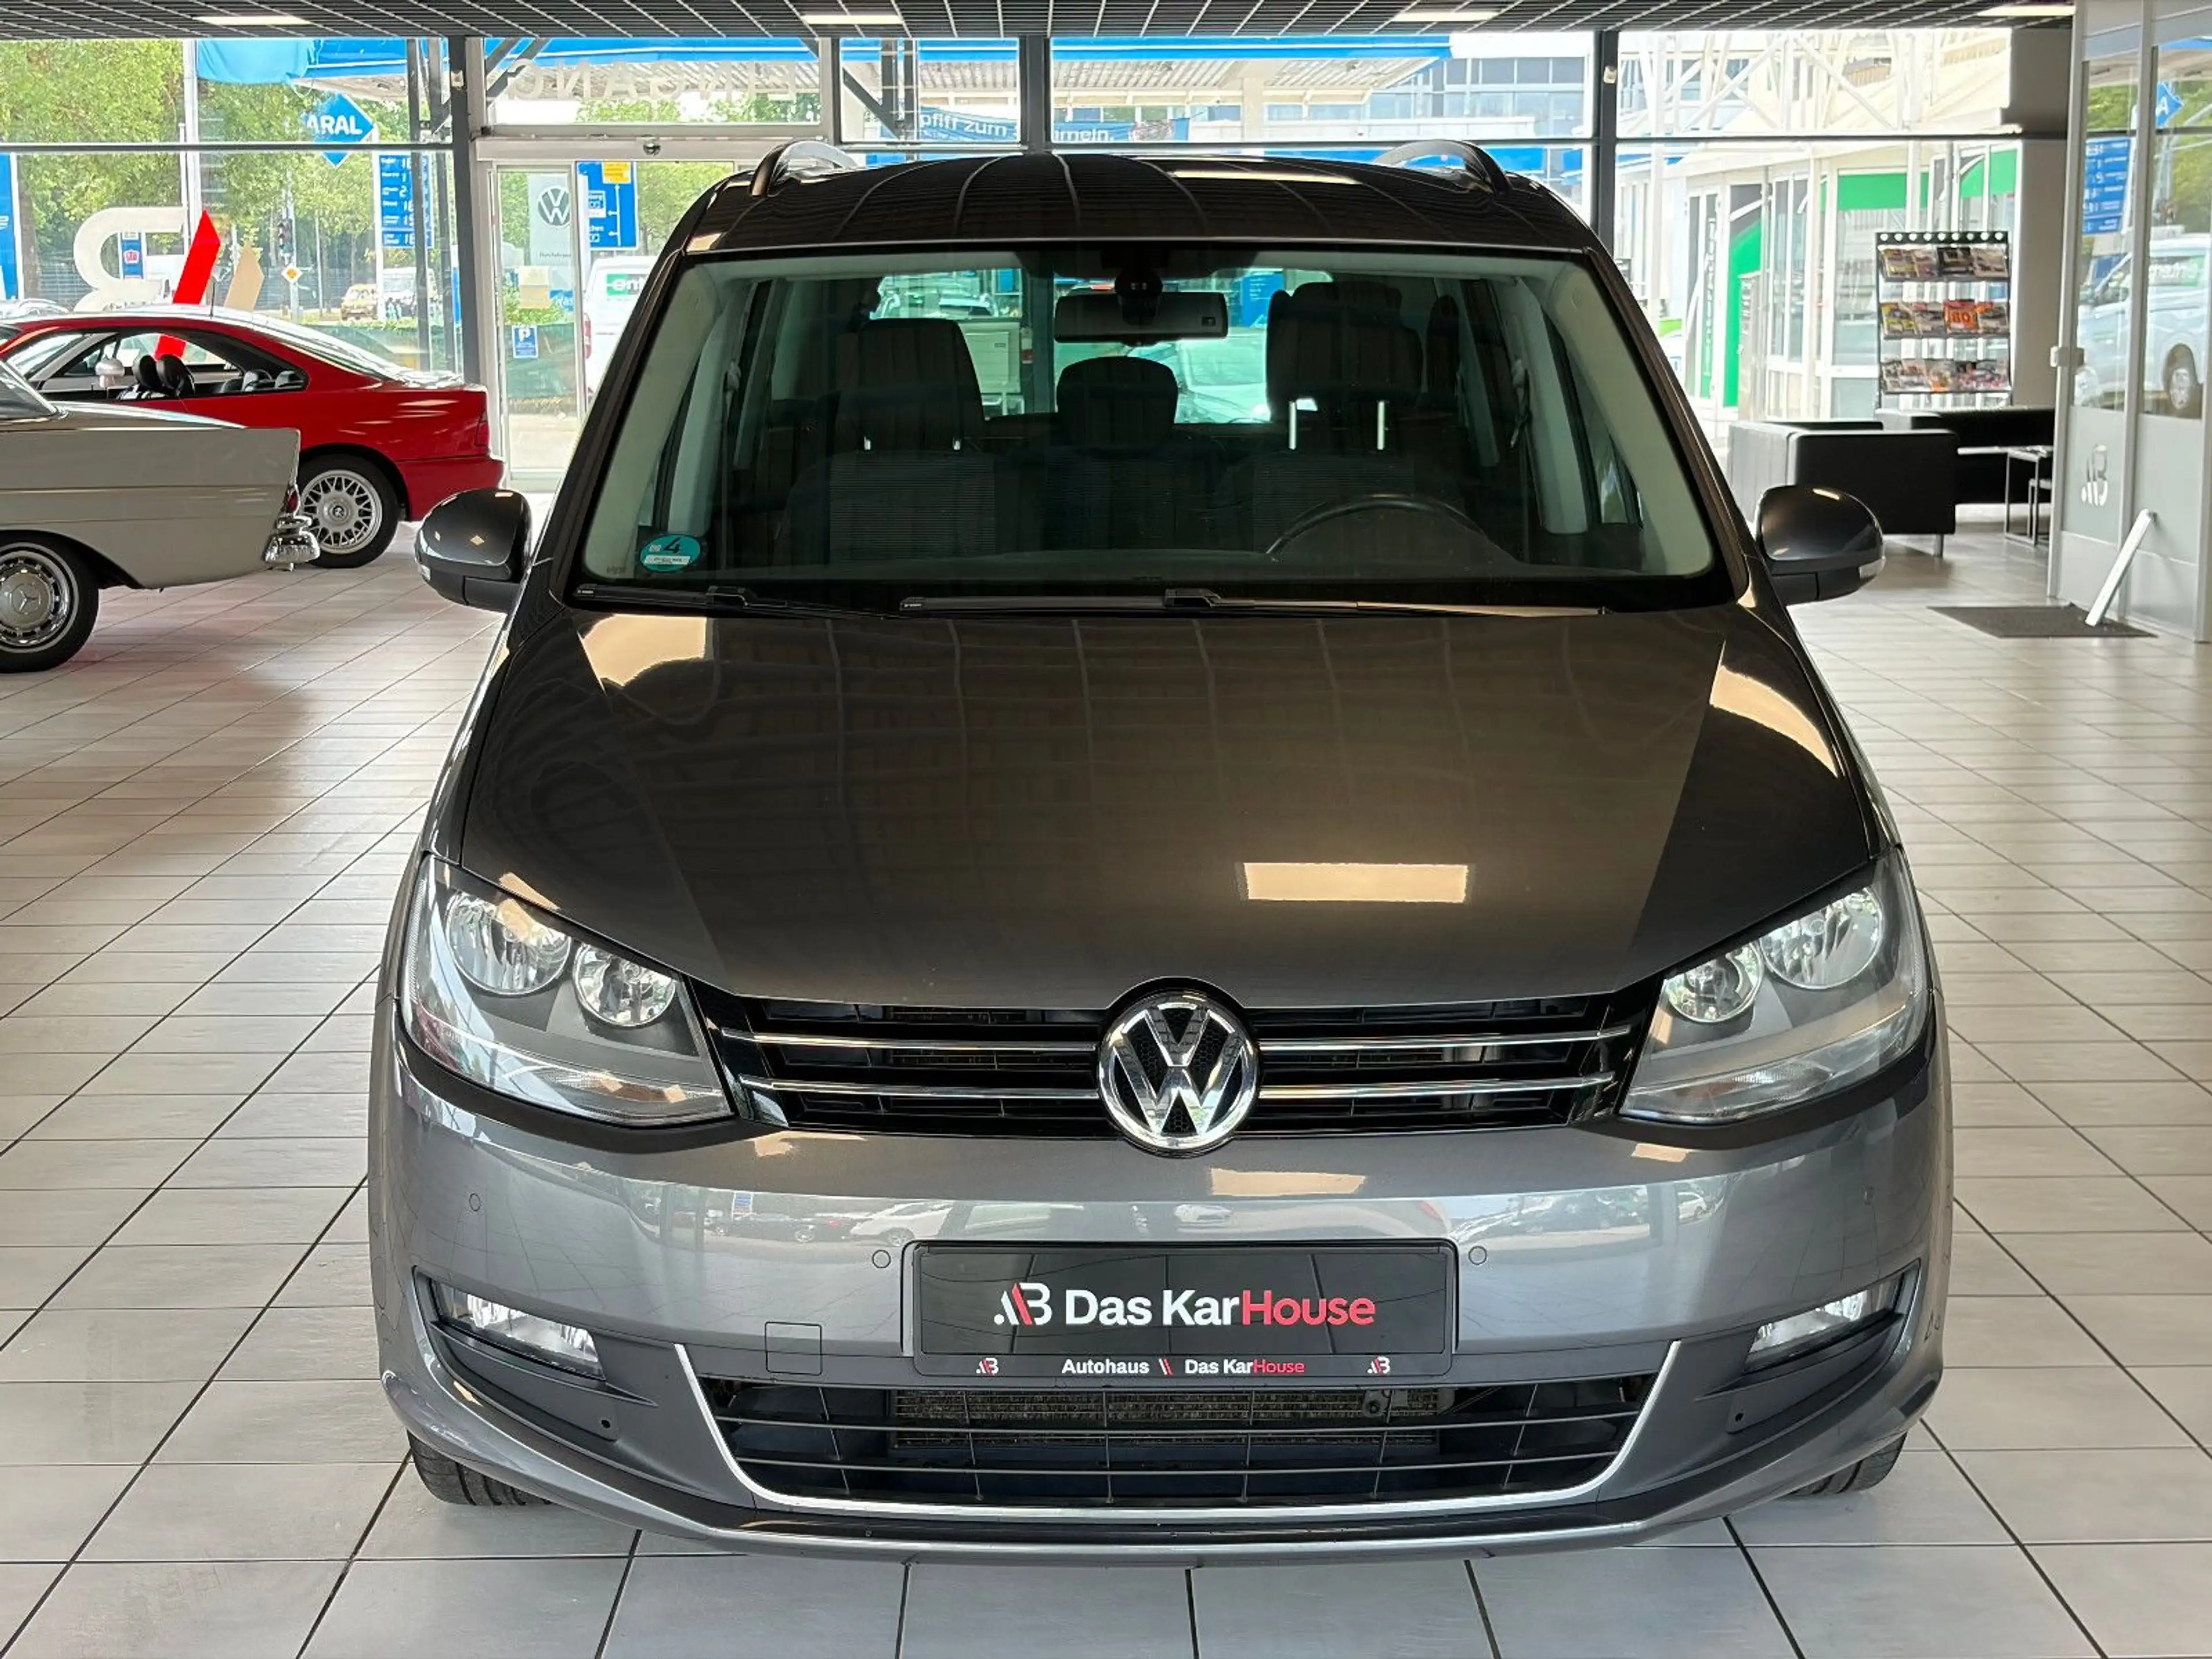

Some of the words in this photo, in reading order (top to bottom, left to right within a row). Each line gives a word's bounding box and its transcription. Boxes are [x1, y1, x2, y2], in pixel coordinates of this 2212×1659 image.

[307, 115, 363, 135] ARAL
[964, 121, 1007, 137] zum
[664, 537, 681, 554] 4
[1066, 1289, 1152, 1325] Das
[1162, 1289, 1376, 1325] KarHouse
[1062, 1358, 1150, 1374] Autohaus
[1184, 1359, 1219, 1374] Das
[1222, 1359, 1305, 1374] KarHouse
